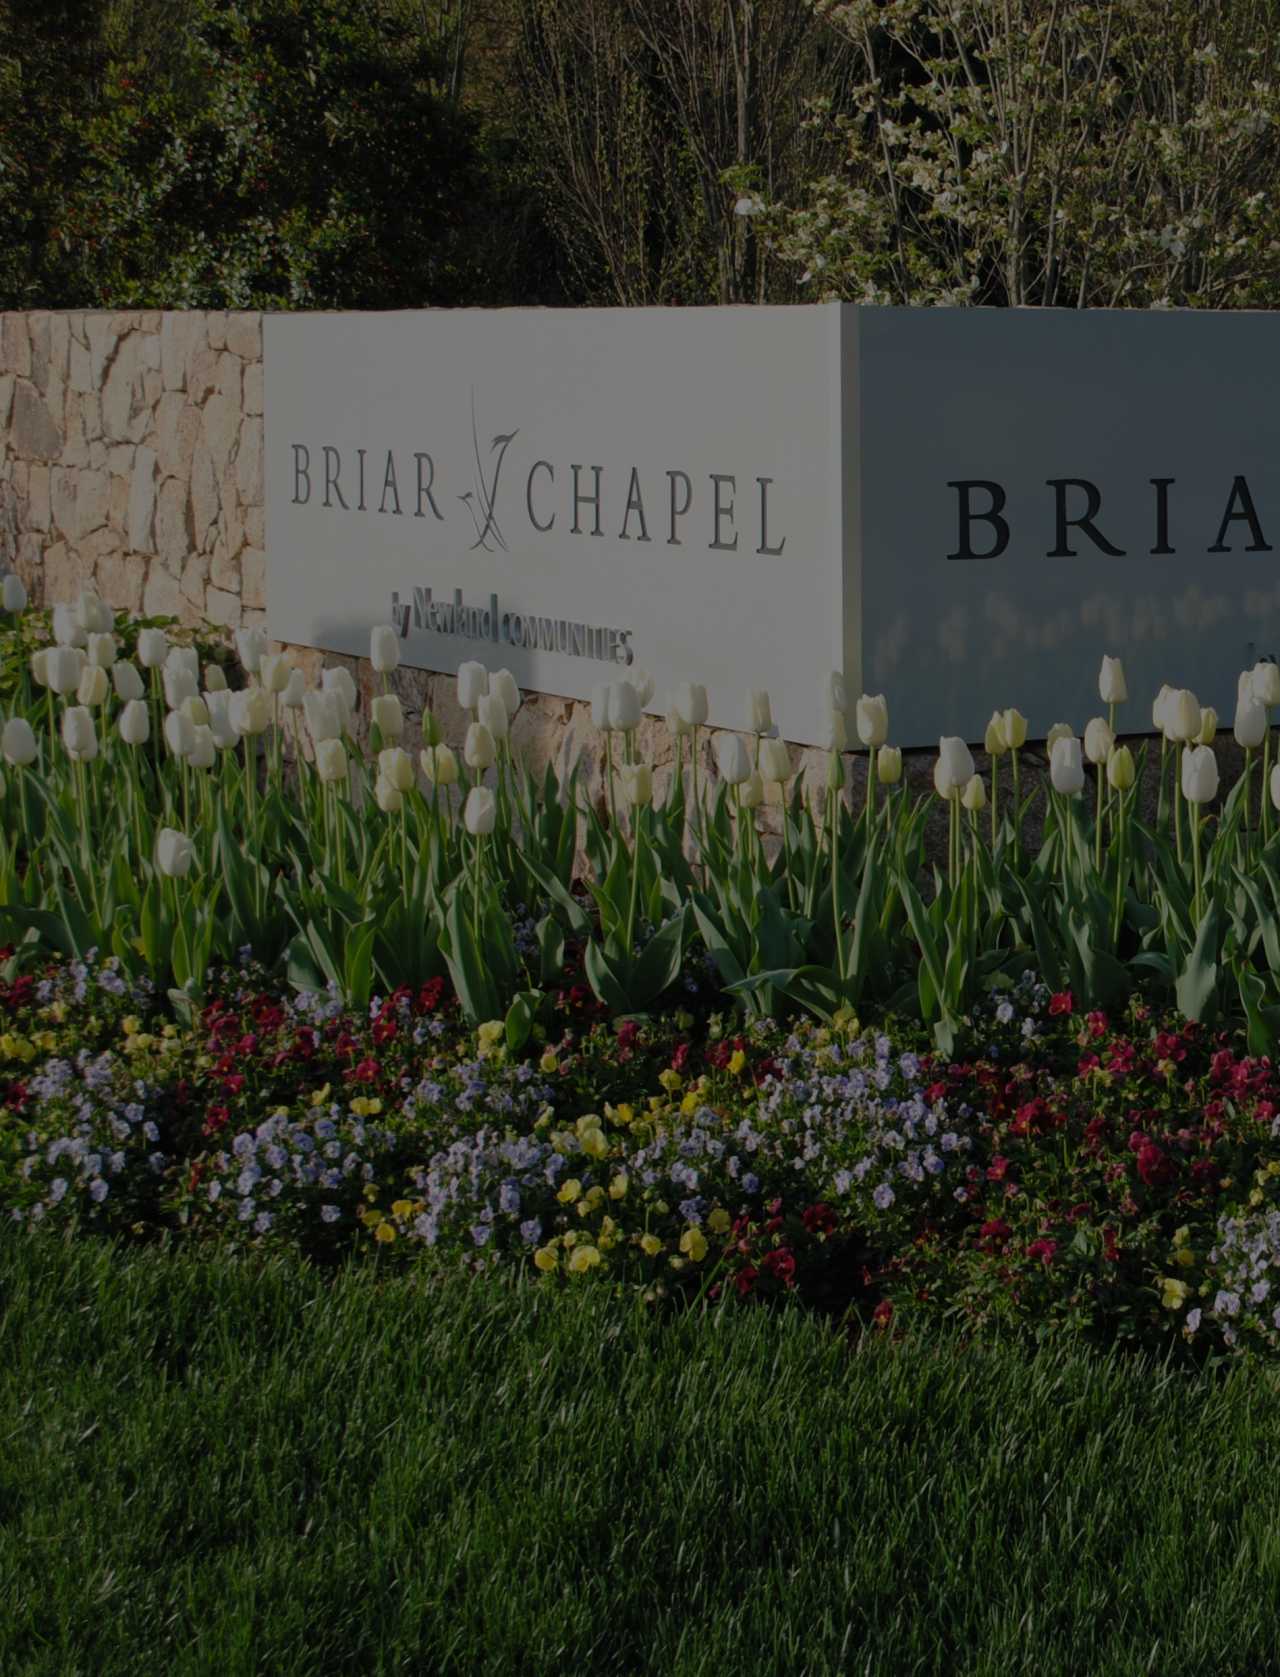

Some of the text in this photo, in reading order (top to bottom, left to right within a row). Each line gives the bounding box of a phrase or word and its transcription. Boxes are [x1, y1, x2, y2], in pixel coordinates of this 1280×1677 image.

[291, 443, 786, 556] BRIAR CHAPEL
[413, 587, 499, 642] Newland
